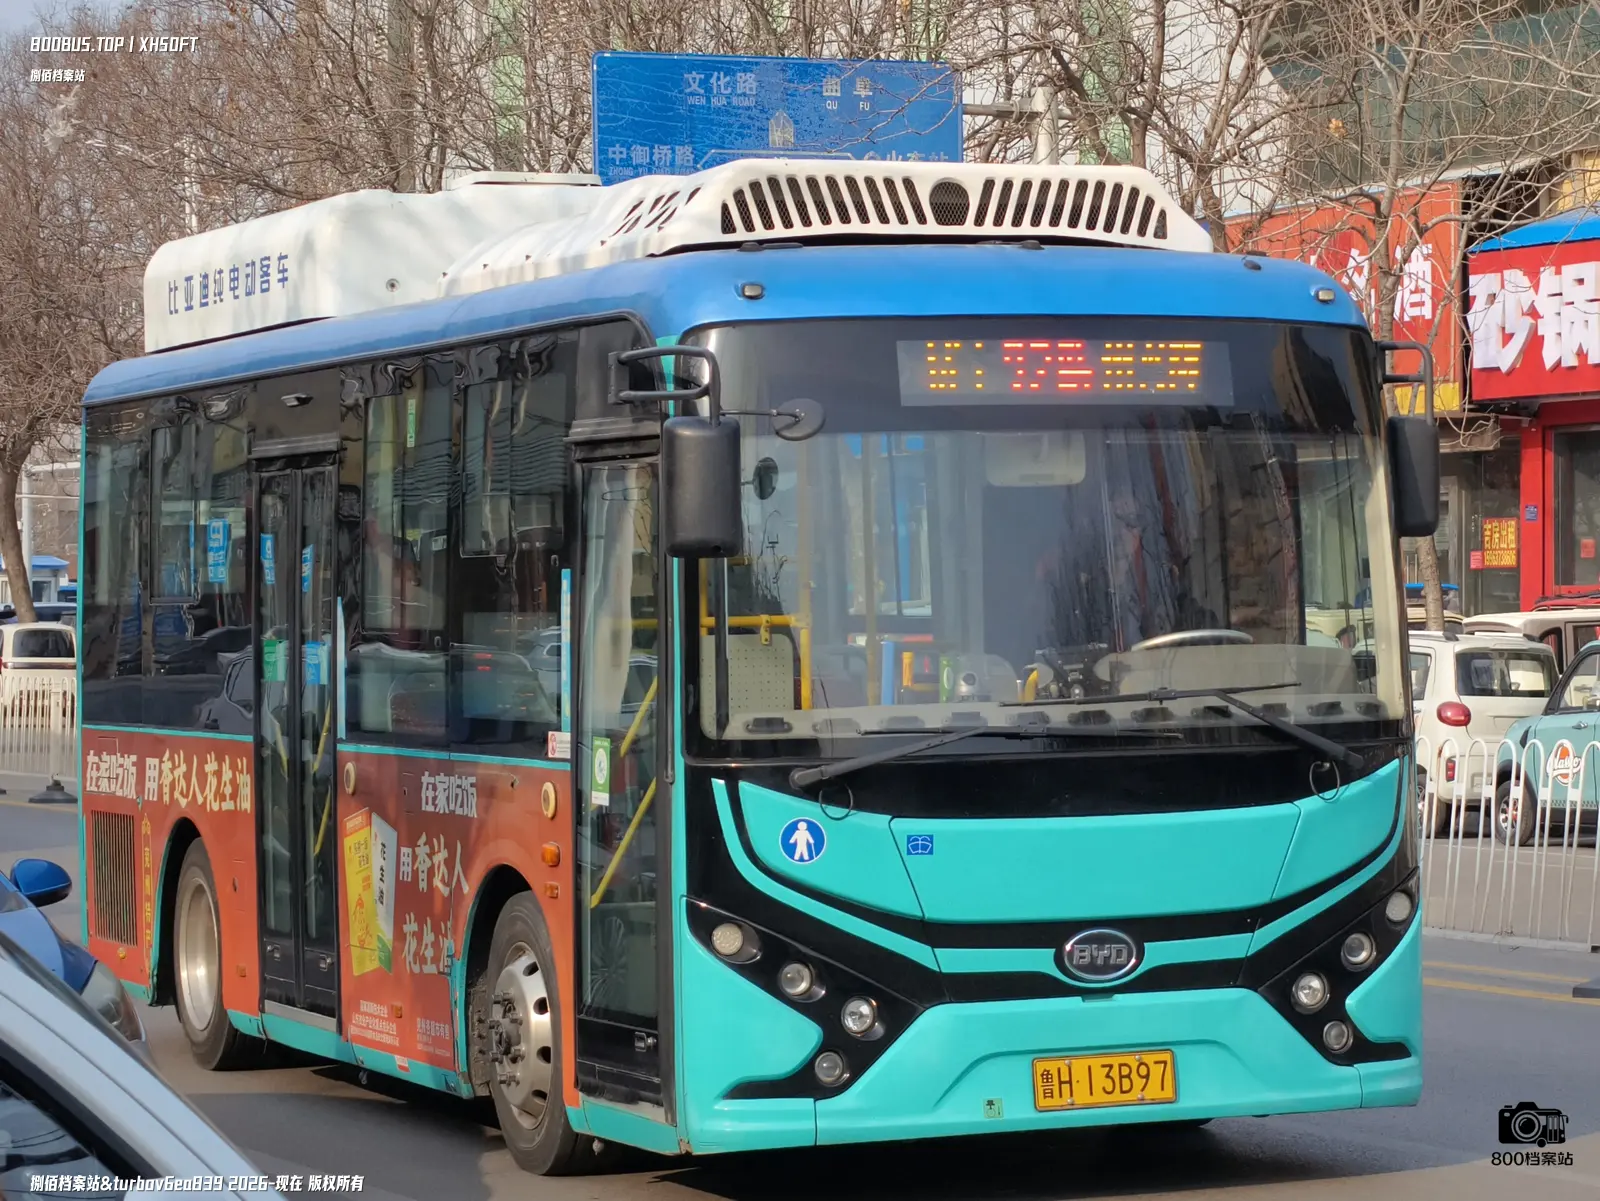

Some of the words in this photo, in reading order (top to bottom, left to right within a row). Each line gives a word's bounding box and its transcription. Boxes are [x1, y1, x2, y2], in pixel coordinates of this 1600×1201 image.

[684, 71, 758, 96] 文化路
[687, 96, 706, 106] WEN
[711, 96, 727, 107] HUA
[733, 96, 756, 108] ROAD
[826, 101, 838, 110] QU
[859, 102, 870, 111] FU
[608, 143, 695, 167] 中御桥路
[608, 166, 634, 177] ZHONG
[168, 252, 289, 315] 比亚迪纯电动客车
[1467, 261, 1600, 374] 砂锅
[1483, 519, 1517, 550] 吉房出租
[86, 750, 138, 799] 在家吃饭
[144, 748, 251, 814] 用香达人花生油
[420, 771, 477, 818] 在家吃饭
[399, 831, 470, 897] 用香达人
[1073, 944, 1129, 965] BYD
